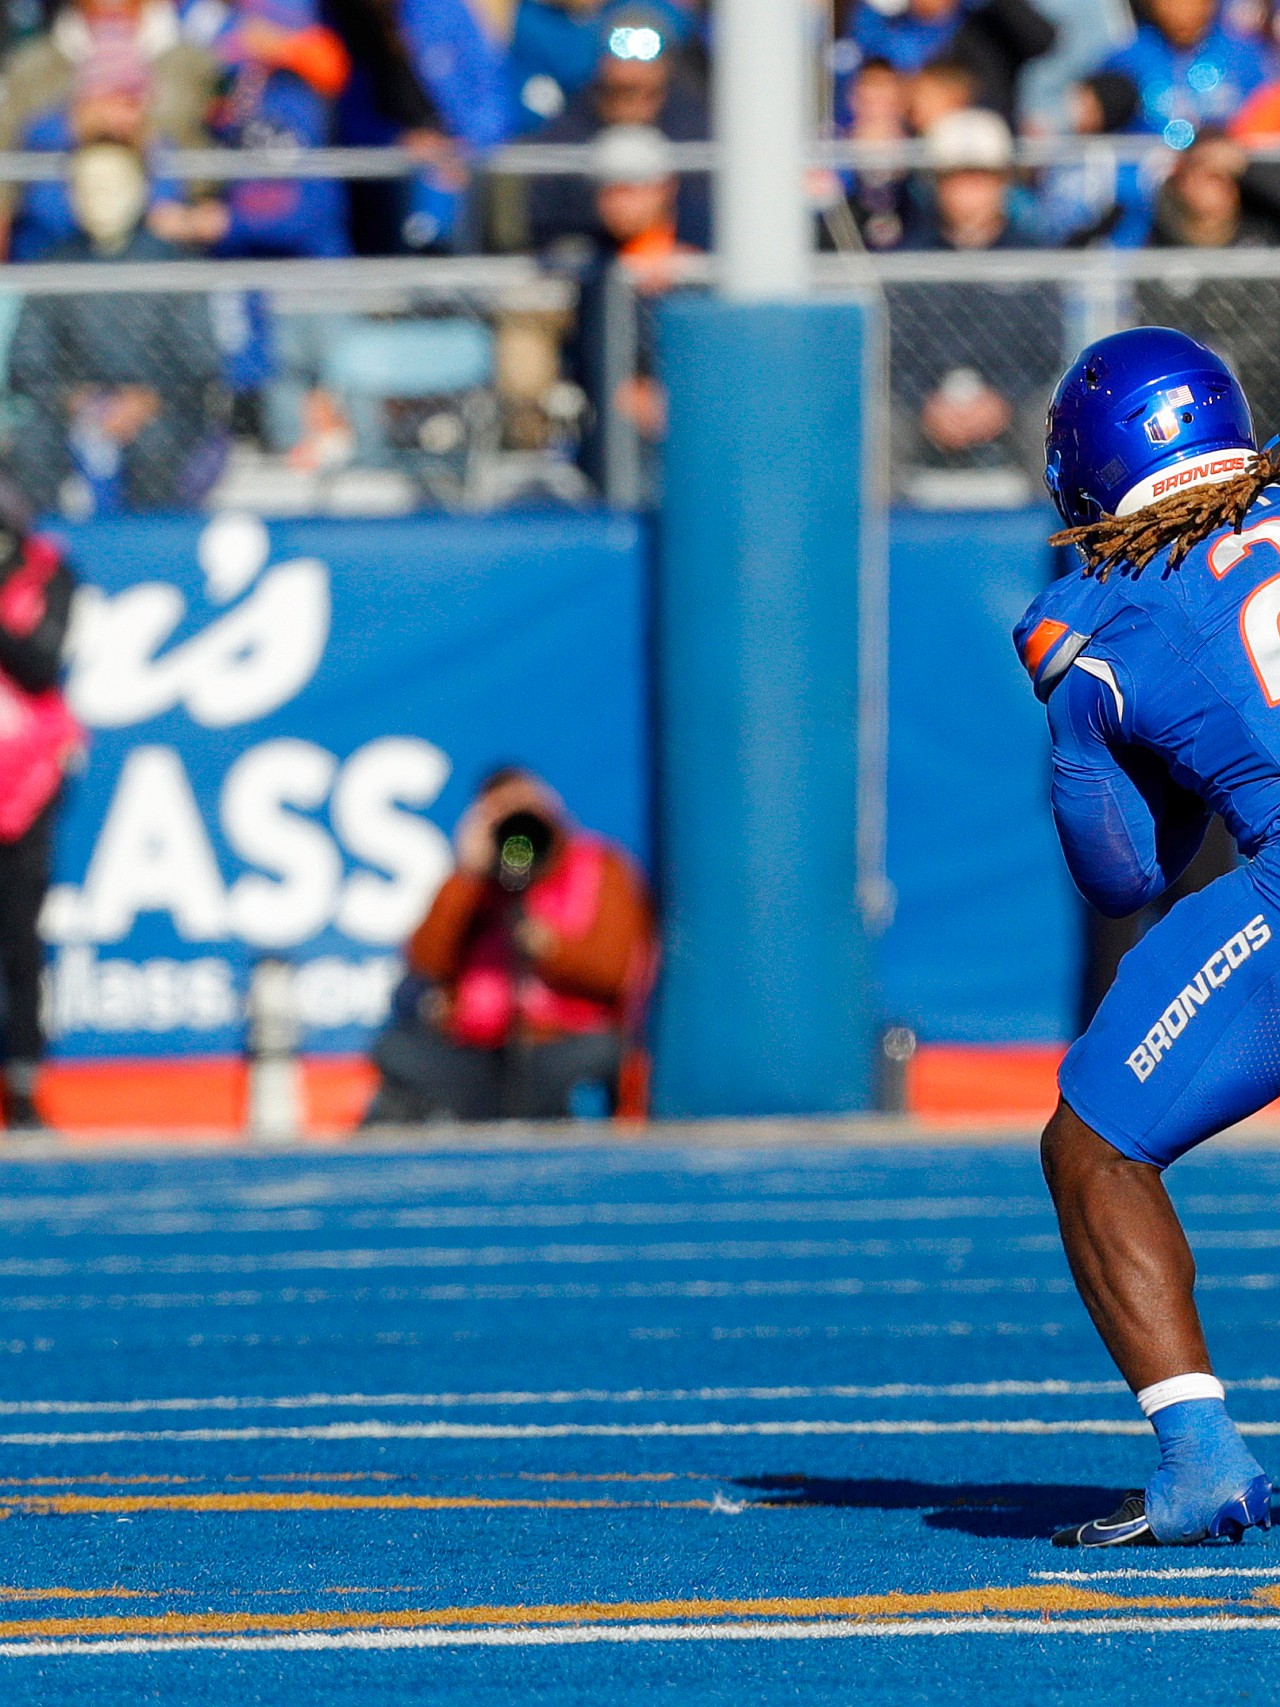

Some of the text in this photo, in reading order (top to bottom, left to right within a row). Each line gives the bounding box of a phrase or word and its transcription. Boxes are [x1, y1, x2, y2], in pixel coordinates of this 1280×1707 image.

[1152, 457, 1245, 497] BRONCOS
[38, 738, 452, 945] ASS
[1124, 914, 1272, 1083] BRONCOS
